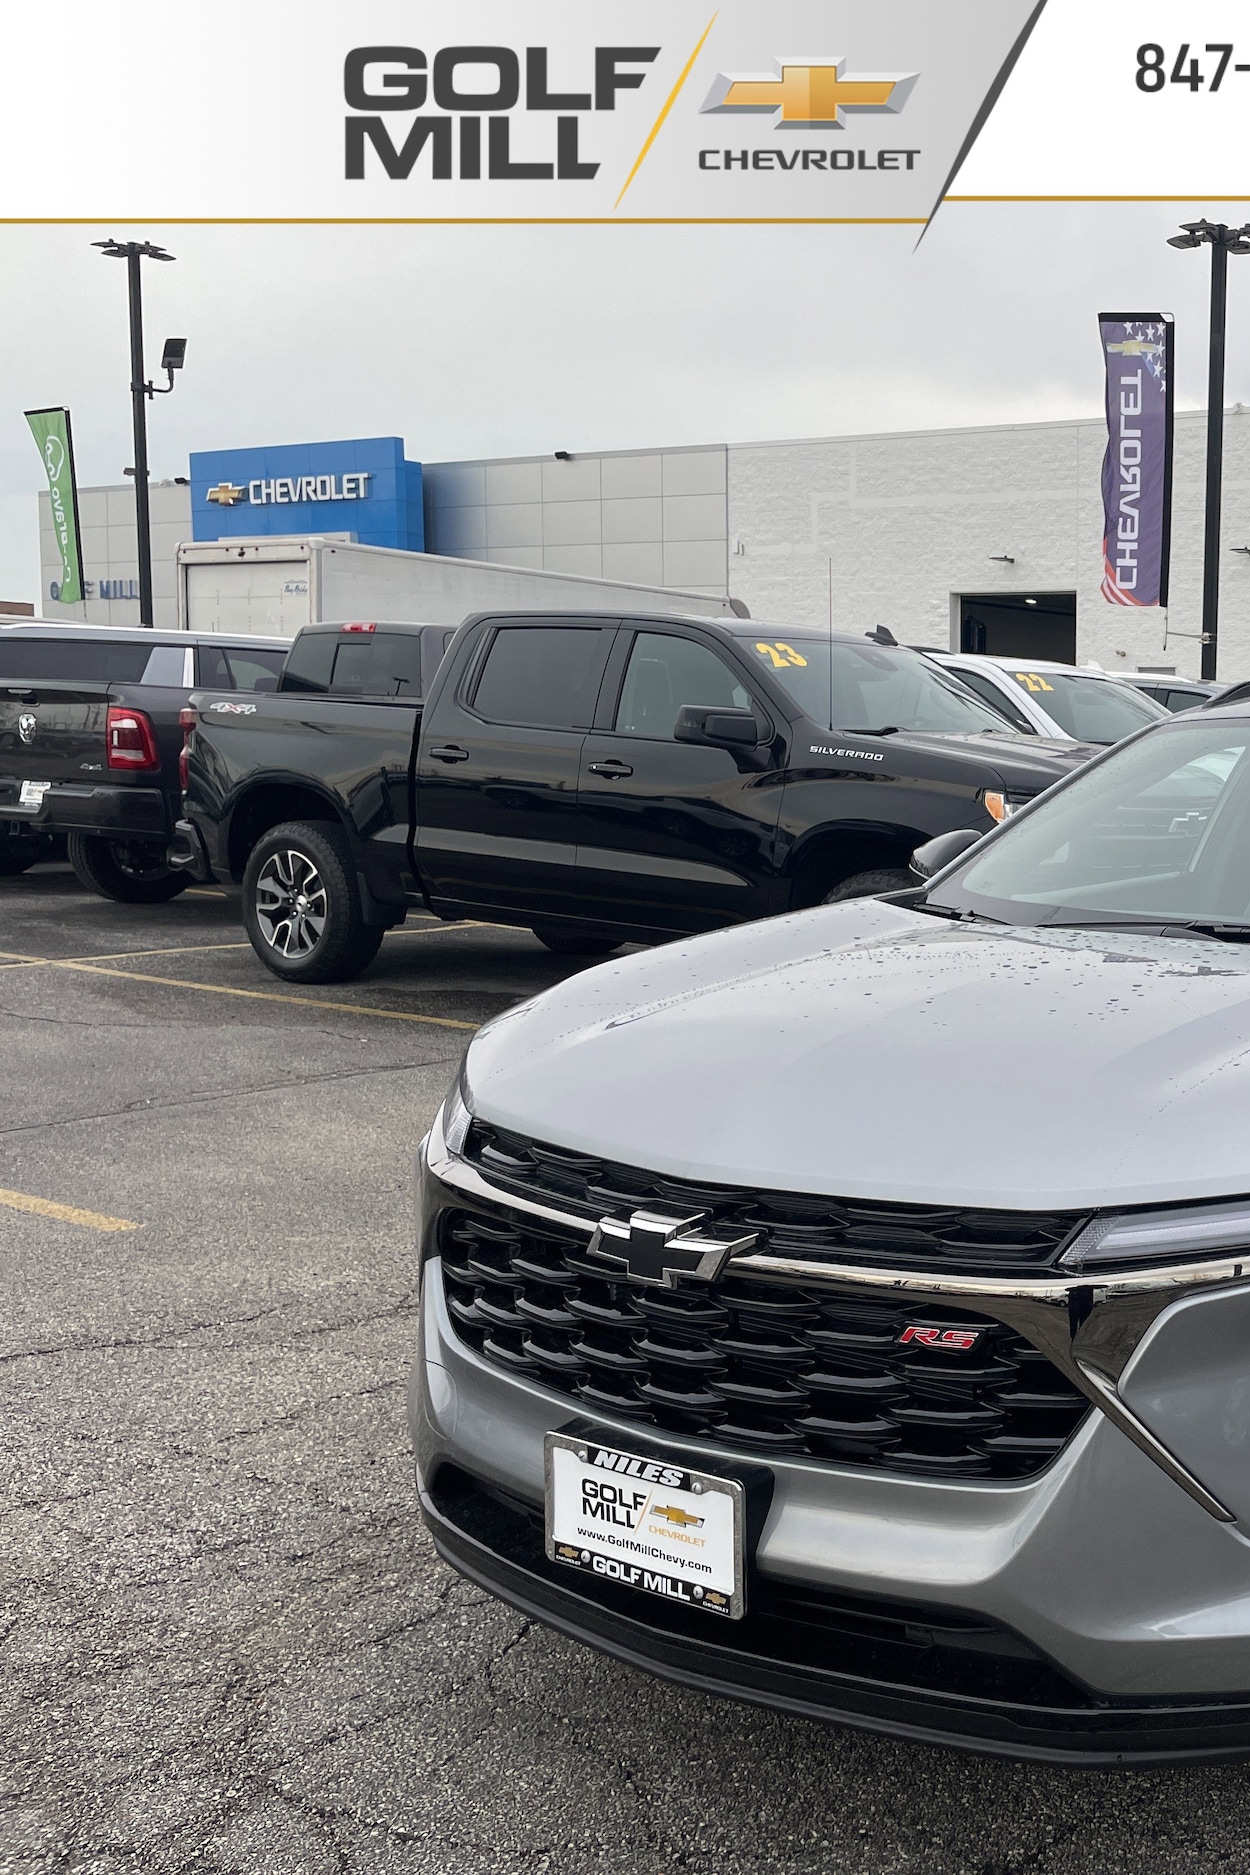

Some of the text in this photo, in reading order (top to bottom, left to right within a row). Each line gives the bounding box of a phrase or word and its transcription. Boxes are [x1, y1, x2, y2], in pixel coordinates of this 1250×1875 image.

[249, 473, 369, 505] CHEVROLET
[756, 642, 808, 668] 23
[1015, 673, 1054, 692] 22
[809, 745, 885, 762] SILVERADO
[899, 1326, 980, 1349] RS
[593, 1450, 684, 1487] NILES
[581, 1478, 648, 1511] GOLF
[582, 1497, 636, 1529] MILL
[577, 1526, 713, 1574] www.GolfMillChevy.com
[648, 1525, 706, 1548] CHEVROLET
[592, 1555, 691, 1601] GOLF MILL
